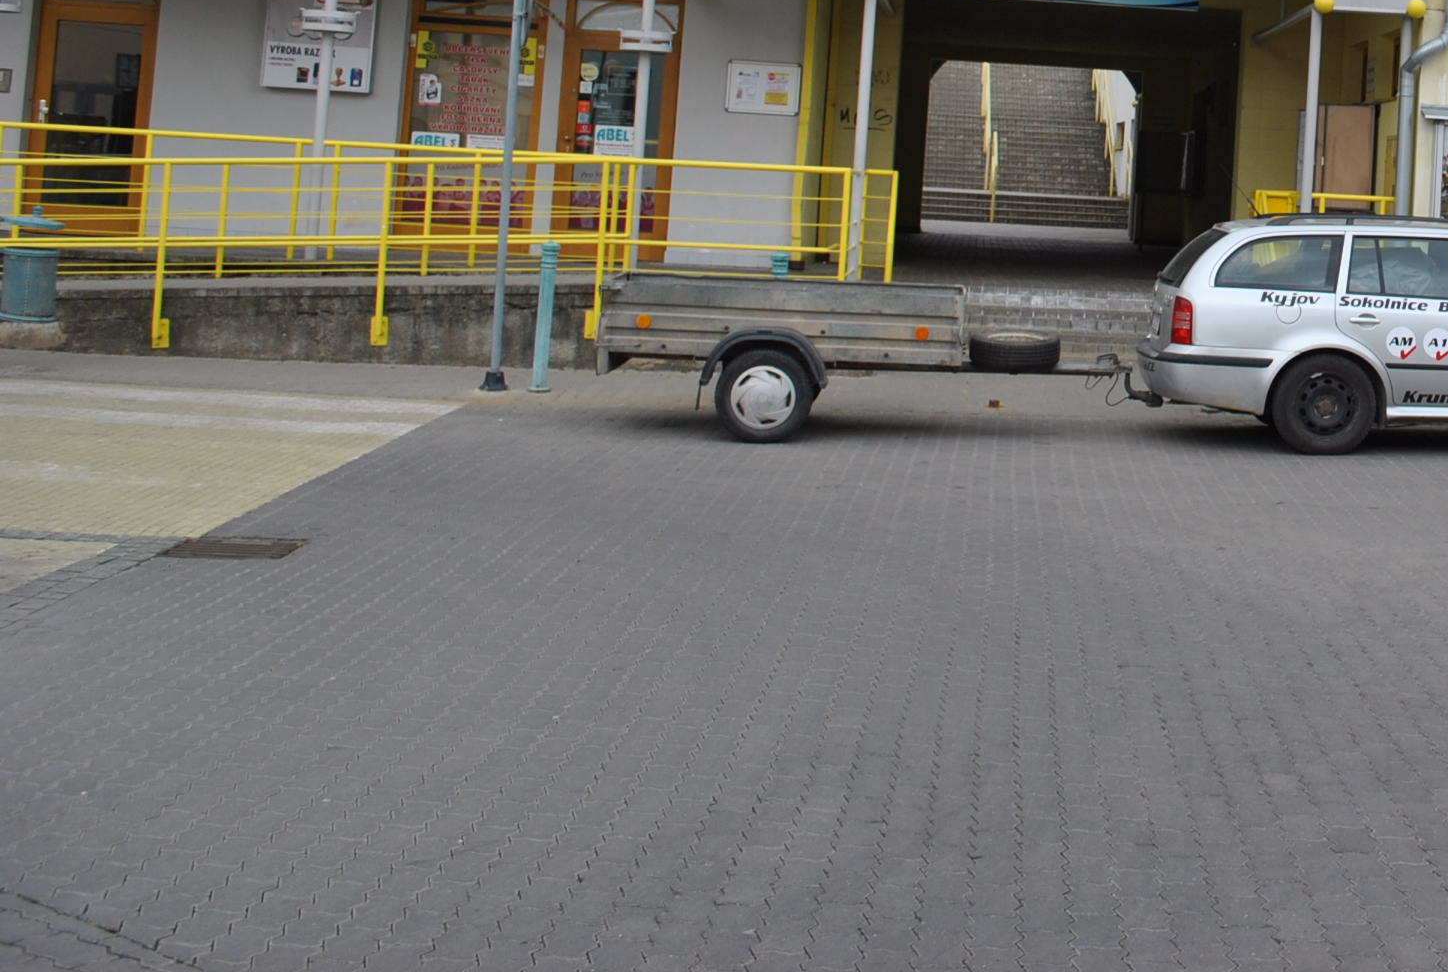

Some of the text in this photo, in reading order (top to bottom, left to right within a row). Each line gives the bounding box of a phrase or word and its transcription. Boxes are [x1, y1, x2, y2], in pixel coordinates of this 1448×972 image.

[269, 42, 302, 57] VÝROBA
[596, 128, 629, 142] ABEL
[1261, 291, 1320, 307] Kyjov
[1339, 295, 1428, 312] Sokolnice
[1389, 336, 1414, 347] AM
[1428, 337, 1448, 348] A1
